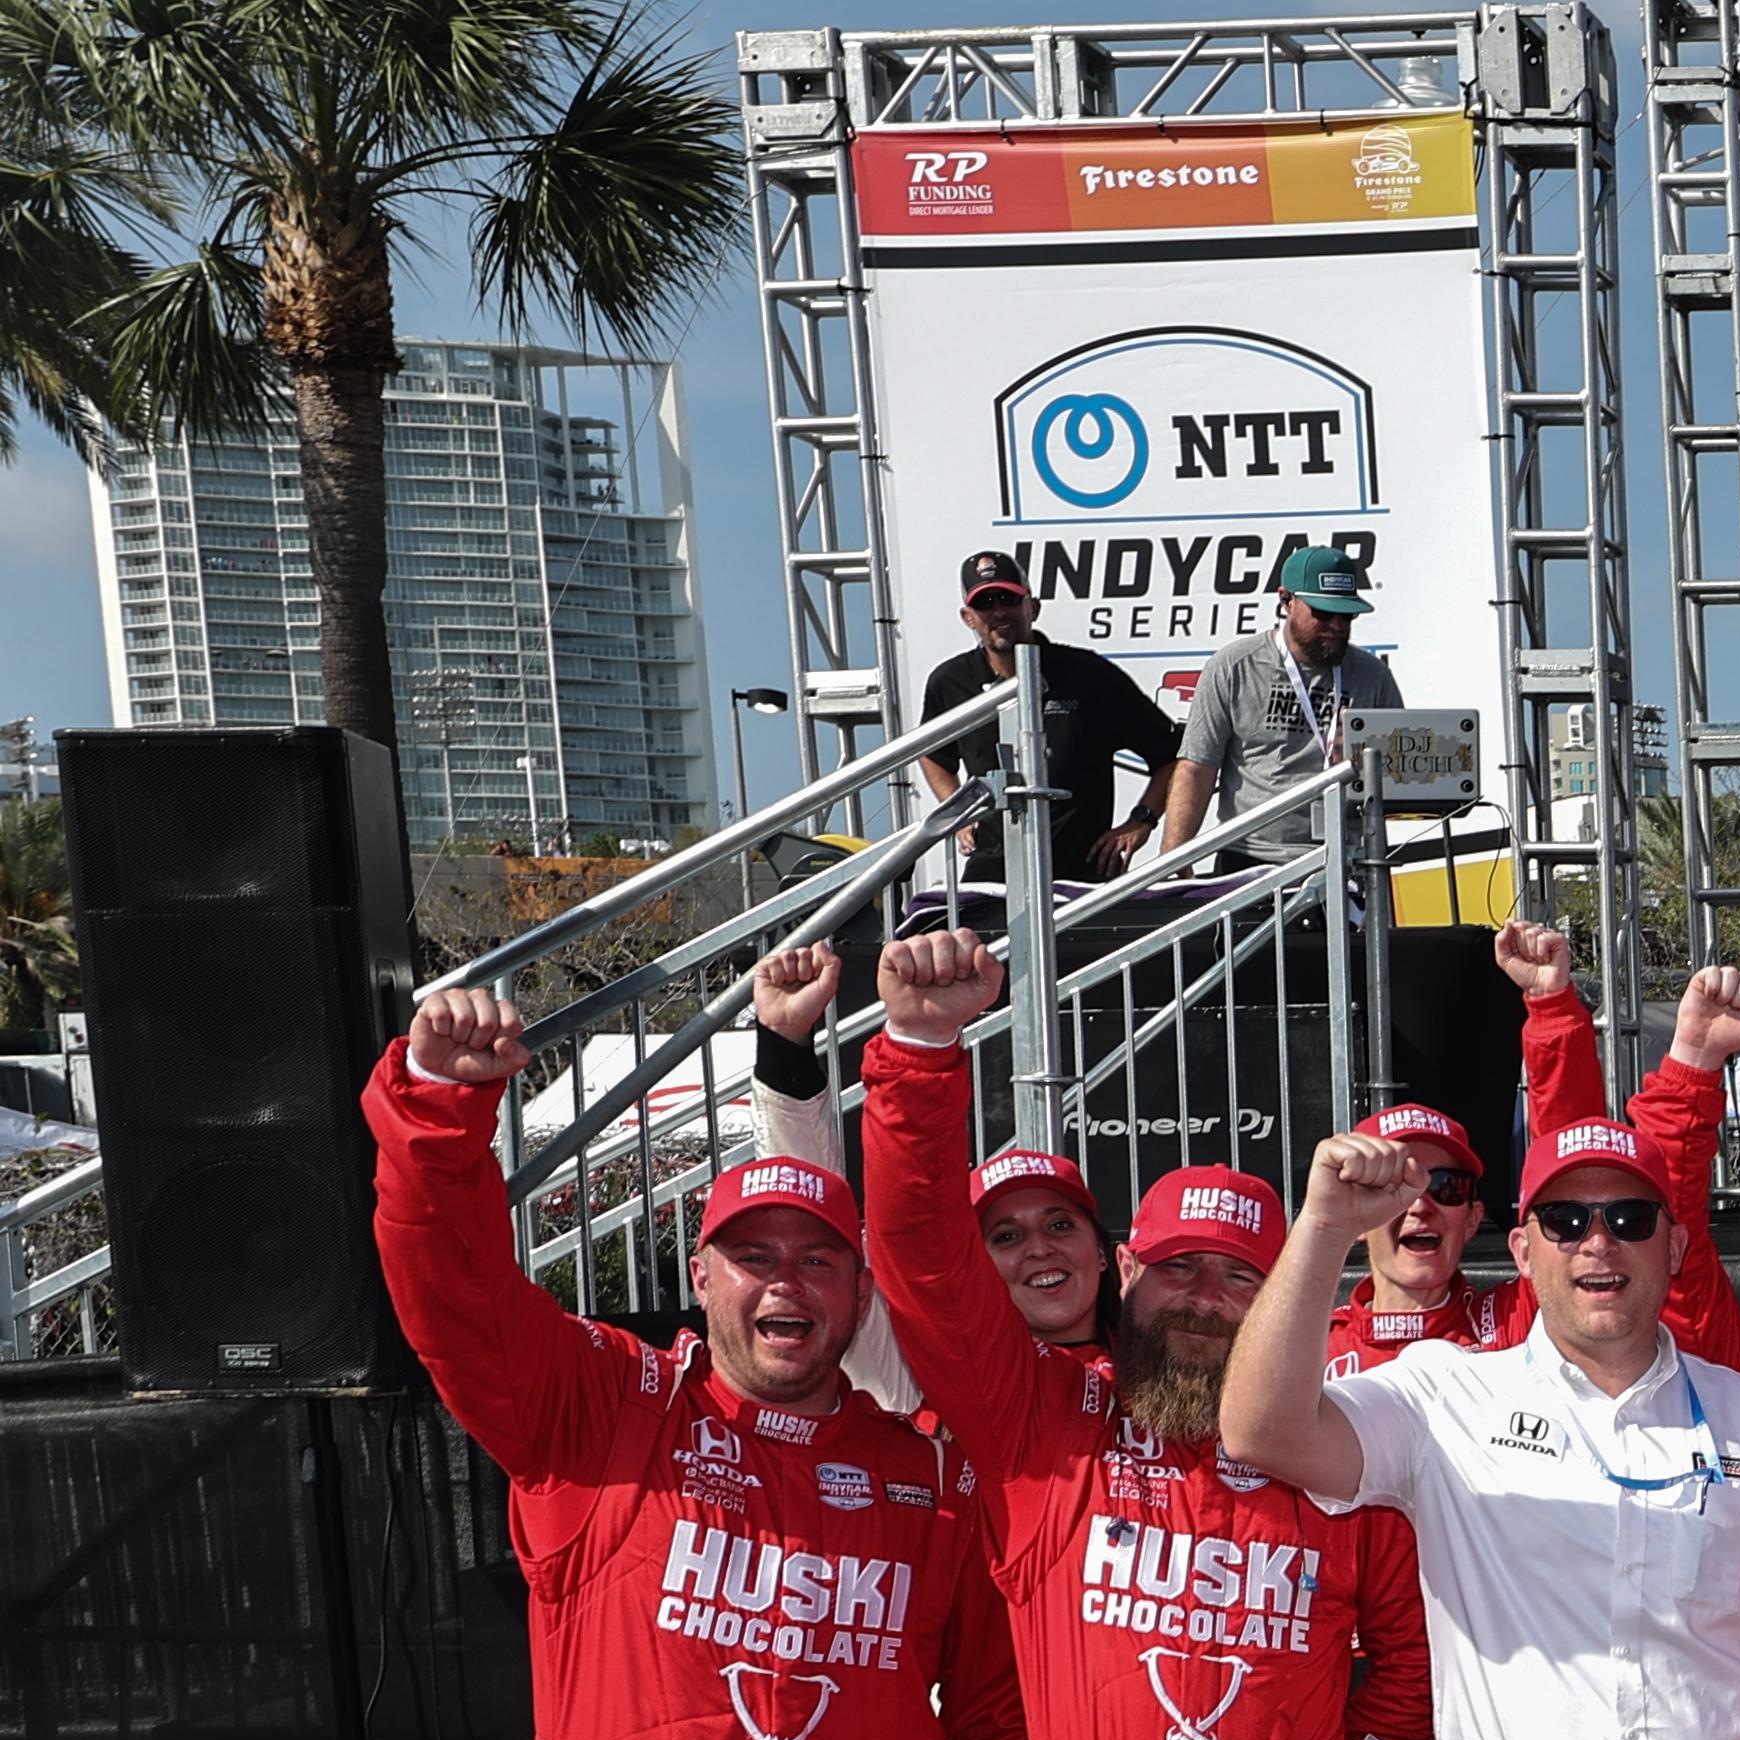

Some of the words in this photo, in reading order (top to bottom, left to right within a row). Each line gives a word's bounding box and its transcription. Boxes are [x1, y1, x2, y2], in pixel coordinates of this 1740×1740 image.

[905, 152, 988, 183] RP
[1080, 163, 1260, 196] Firestone
[909, 185, 992, 201] FUNDING
[909, 205, 931, 216] DIRECT
[933, 204, 967, 215] MORTGAGE
[968, 203, 994, 214] LENDER
[1173, 411, 1342, 480] NTT
[1014, 530, 1378, 602] INDYCAR
[1394, 735, 1433, 754] DJ
[1063, 1111, 1222, 1137] Pioneer
[1555, 1125, 1633, 1151] HUSKI
[1181, 1187, 1261, 1222] HUSKI
[1373, 1313, 1425, 1332] HUSKI
[224, 1347, 273, 1360] QSC
[757, 1408, 820, 1437] HUSKI
[1490, 1436, 1559, 1458] HONDA
[662, 1519, 913, 1633] HUSKI
[1082, 1514, 1321, 1618] HUSKI
[655, 1595, 903, 1671] CHOCOLATE
[1082, 1593, 1311, 1653] CHOCOLATE
